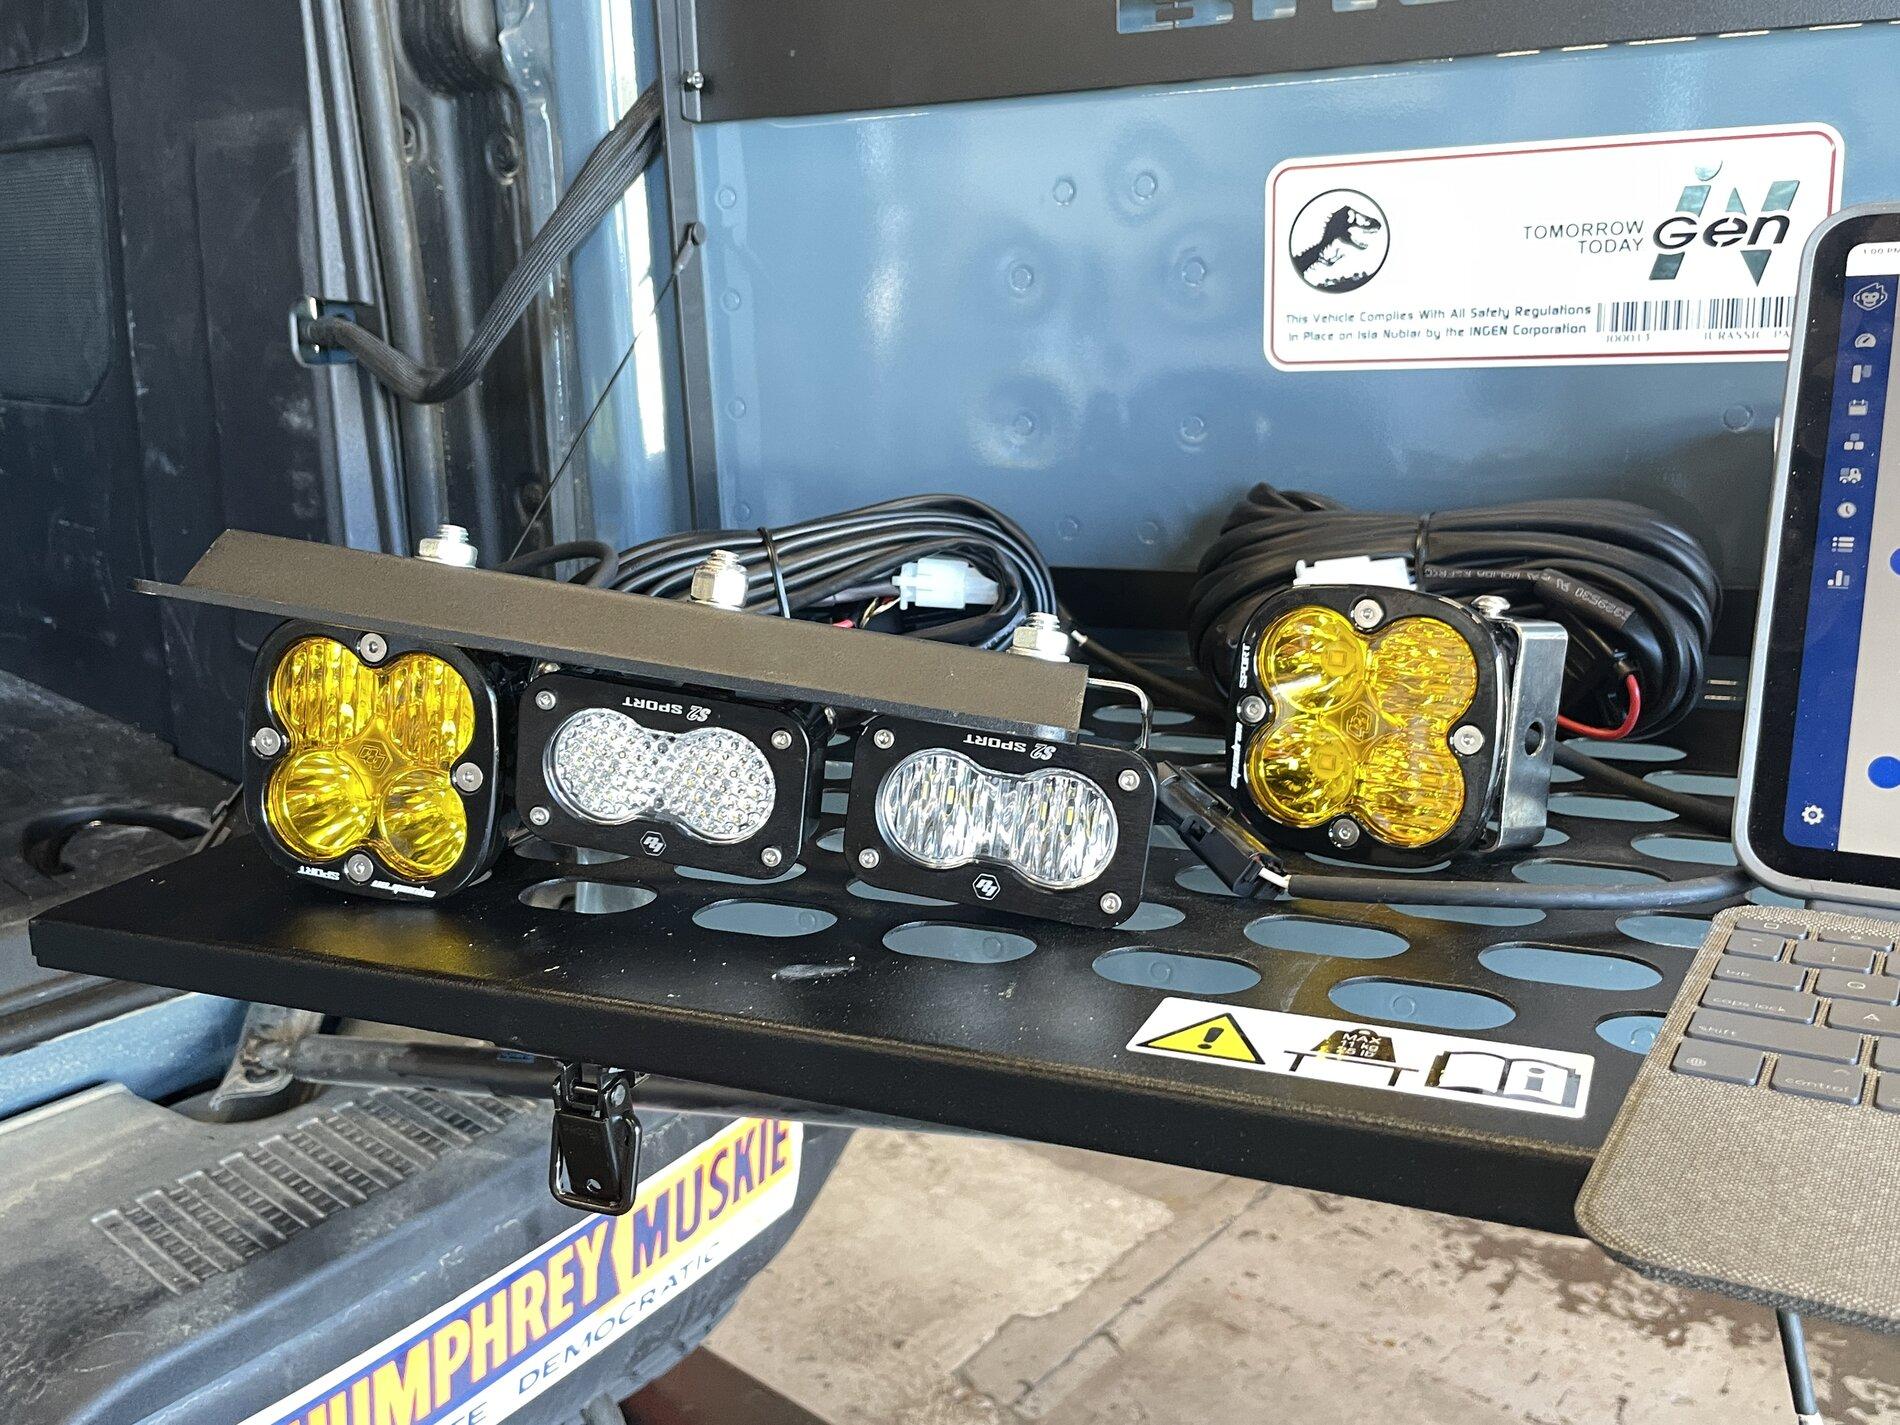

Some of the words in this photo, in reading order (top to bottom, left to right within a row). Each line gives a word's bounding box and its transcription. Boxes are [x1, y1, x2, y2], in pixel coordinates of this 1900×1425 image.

[1523, 220, 1644, 240] TOMORROW
[1578, 237, 1644, 255] TODAY
[1286, 313, 1308, 324] This
[1312, 312, 1355, 323] Vehicle
[1359, 310, 1414, 322] Complies
[1419, 308, 1445, 319] With
[1450, 307, 1466, 319] All
[1470, 306, 1510, 320] Safety
[1515, 304, 1592, 319] Regulations
[1303, 331, 1334, 341] Place
[1339, 332, 1353, 341] on
[1357, 329, 1378, 340] Isla
[1383, 328, 1422, 340] Nublar
[1426, 328, 1441, 341] by
[1445, 327, 1465, 338] the
[1469, 325, 1508, 337] INGEN
[1513, 322, 1587, 338] Corporation
[1239, 643, 1250, 688] SPORT
[622, 696, 683, 715] SPORT
[962, 734, 1028, 753] SPORT
[297, 865, 340, 880] SPORT
[1340, 1040, 1355, 1048] 11
[1342, 1033, 1382, 1045] MAX
[632, 1118, 790, 1279] MUSKIE
[518, 1241, 721, 1396] DEMOCRATIC
